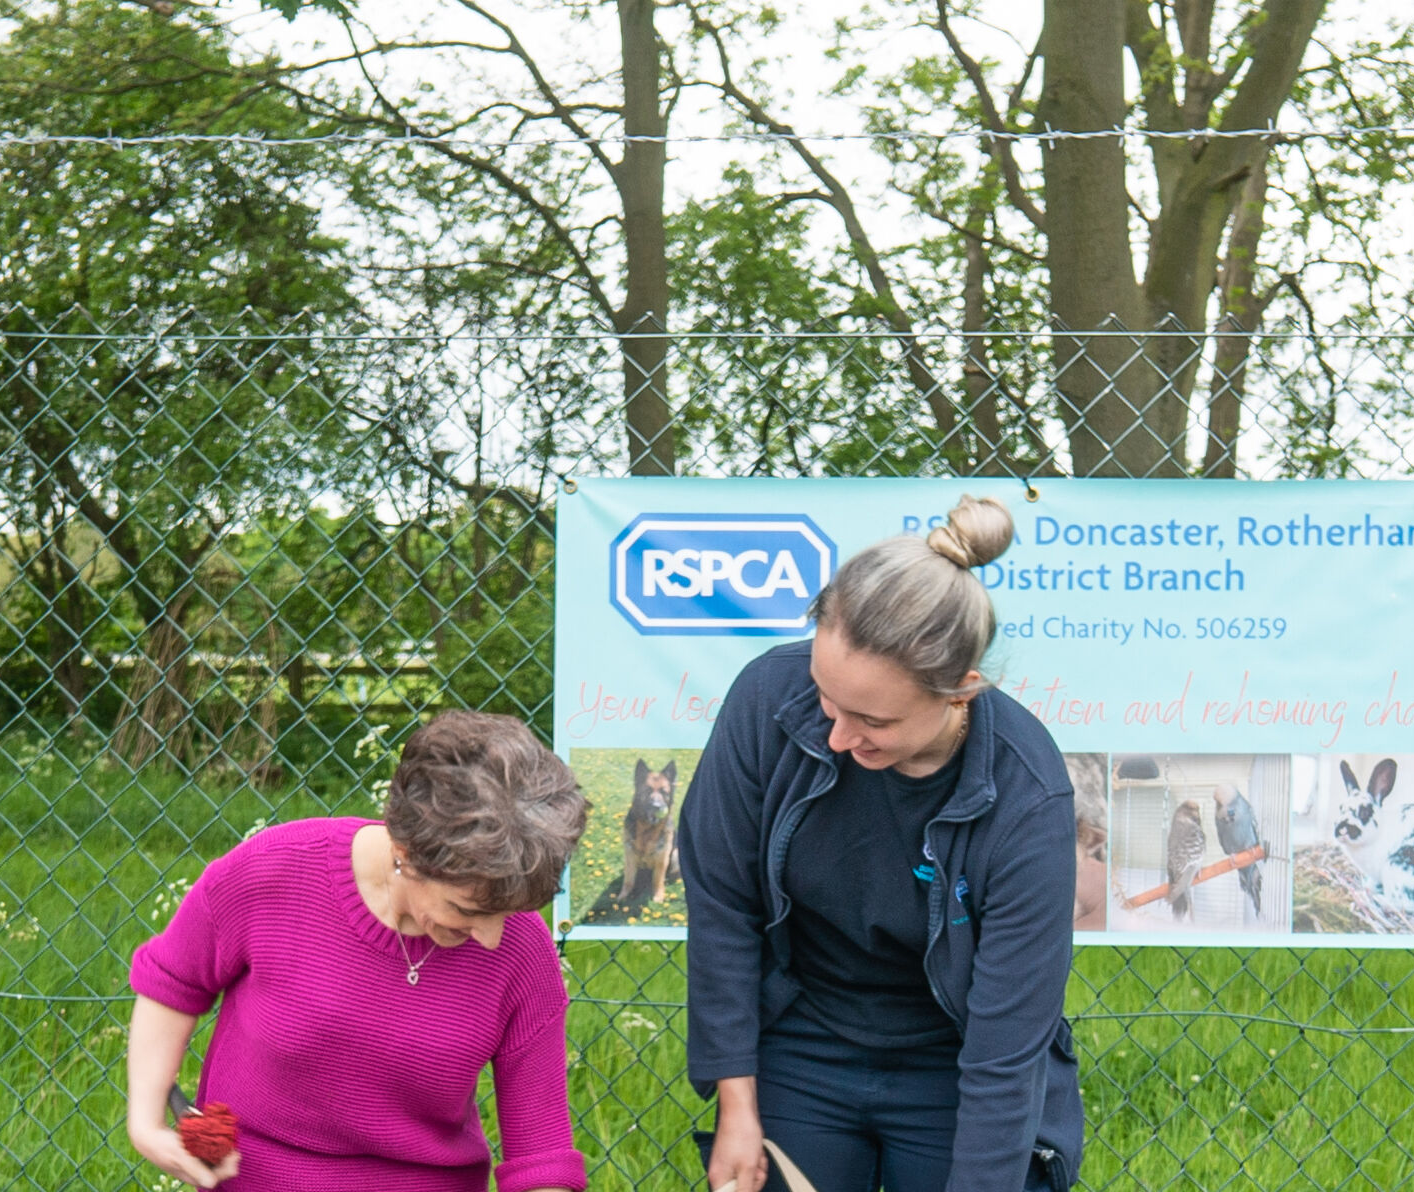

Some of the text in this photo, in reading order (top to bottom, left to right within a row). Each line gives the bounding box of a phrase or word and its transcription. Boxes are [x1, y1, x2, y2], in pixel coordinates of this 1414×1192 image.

[1035, 514, 1225, 552] Doncaster,
[641, 548, 809, 599] RSPCA
[980, 560, 1245, 592] District Branch
[1042, 615, 1134, 646] Charity
[1143, 616, 1187, 640] No.
[1195, 616, 1288, 640] 506259
[565, 671, 723, 740] Your loc
[1123, 670, 1194, 733] and
[1201, 670, 1348, 749] rehoming
